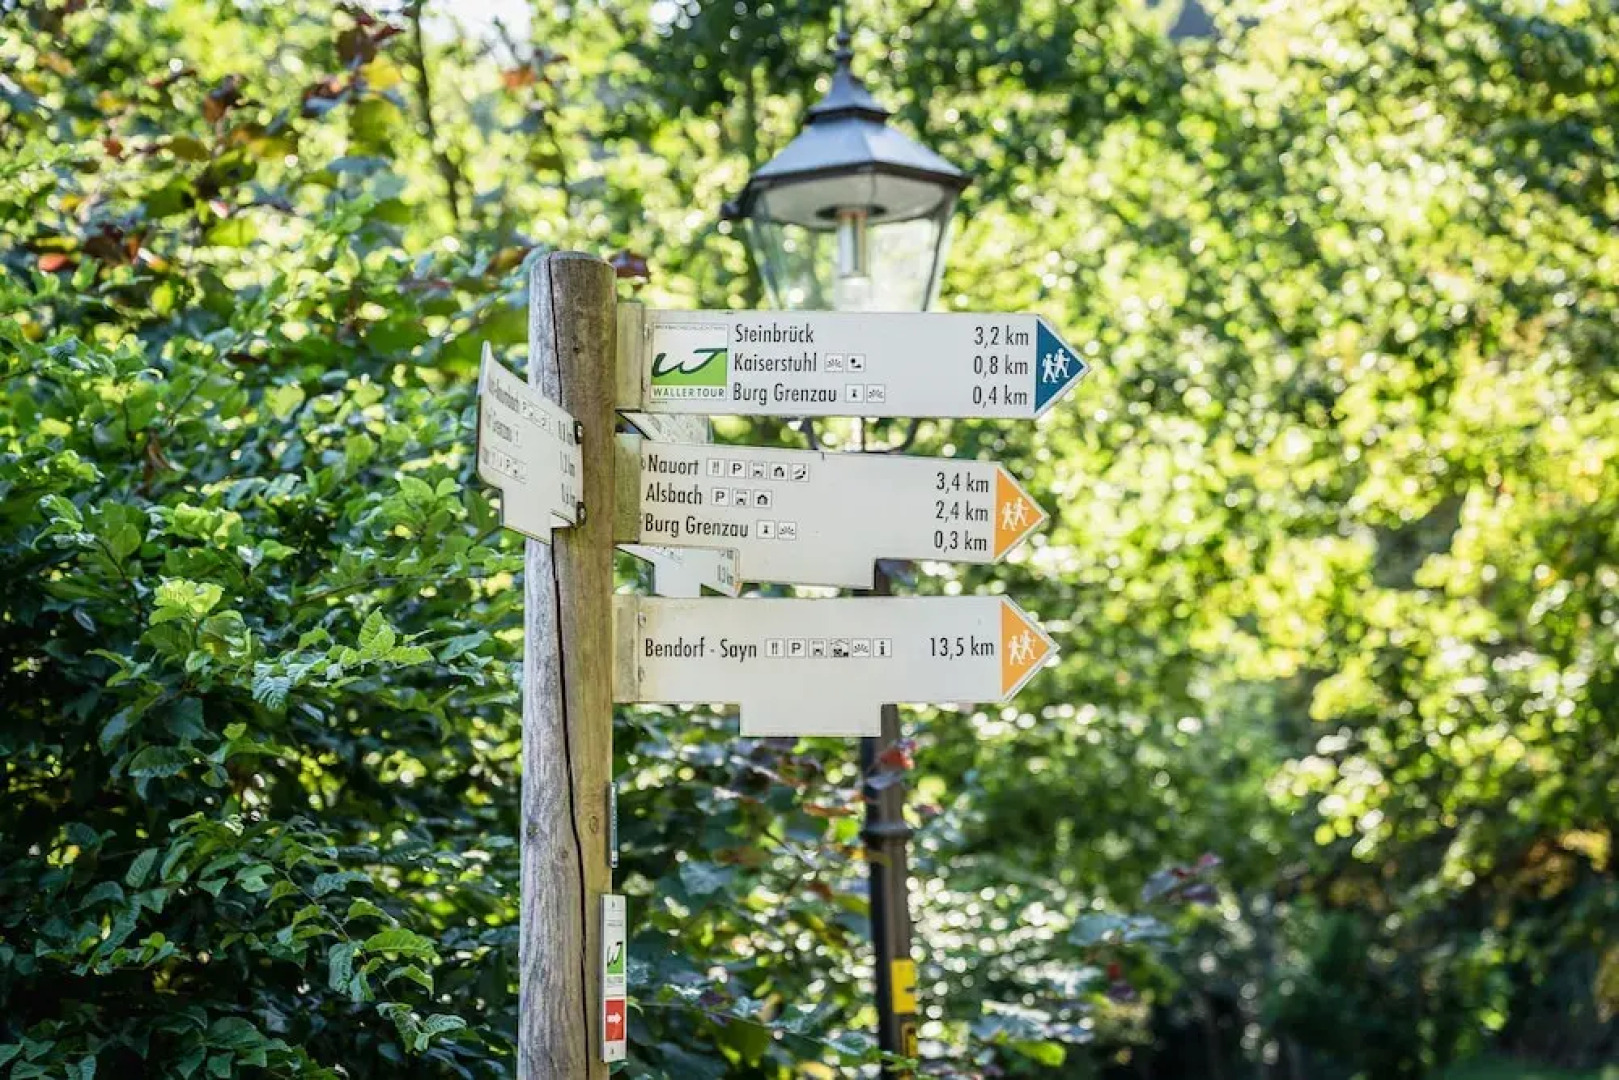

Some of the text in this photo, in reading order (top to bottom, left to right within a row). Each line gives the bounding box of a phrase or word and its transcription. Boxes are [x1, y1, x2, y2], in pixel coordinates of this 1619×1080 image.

[735, 323, 1029, 348] Steinbrück 3,2 km
[735, 352, 1028, 377] Kaiserstuhl 0,8 km
[653, 388, 725, 398] WALLERTOUR
[734, 383, 1027, 408] Burg Grenzau 0,4 km
[648, 454, 698, 475] Nauort
[936, 472, 960, 494] 3,4
[966, 472, 989, 492] km
[646, 482, 702, 505] Alsbach
[936, 500, 959, 523] 2,4
[965, 500, 988, 521] km
[645, 513, 986, 553] Burg Grenzau 0,3 km
[646, 636, 705, 657] Bendorf
[720, 638, 757, 662] Sayn
[930, 638, 964, 660] 13,5
[971, 635, 995, 656] km
